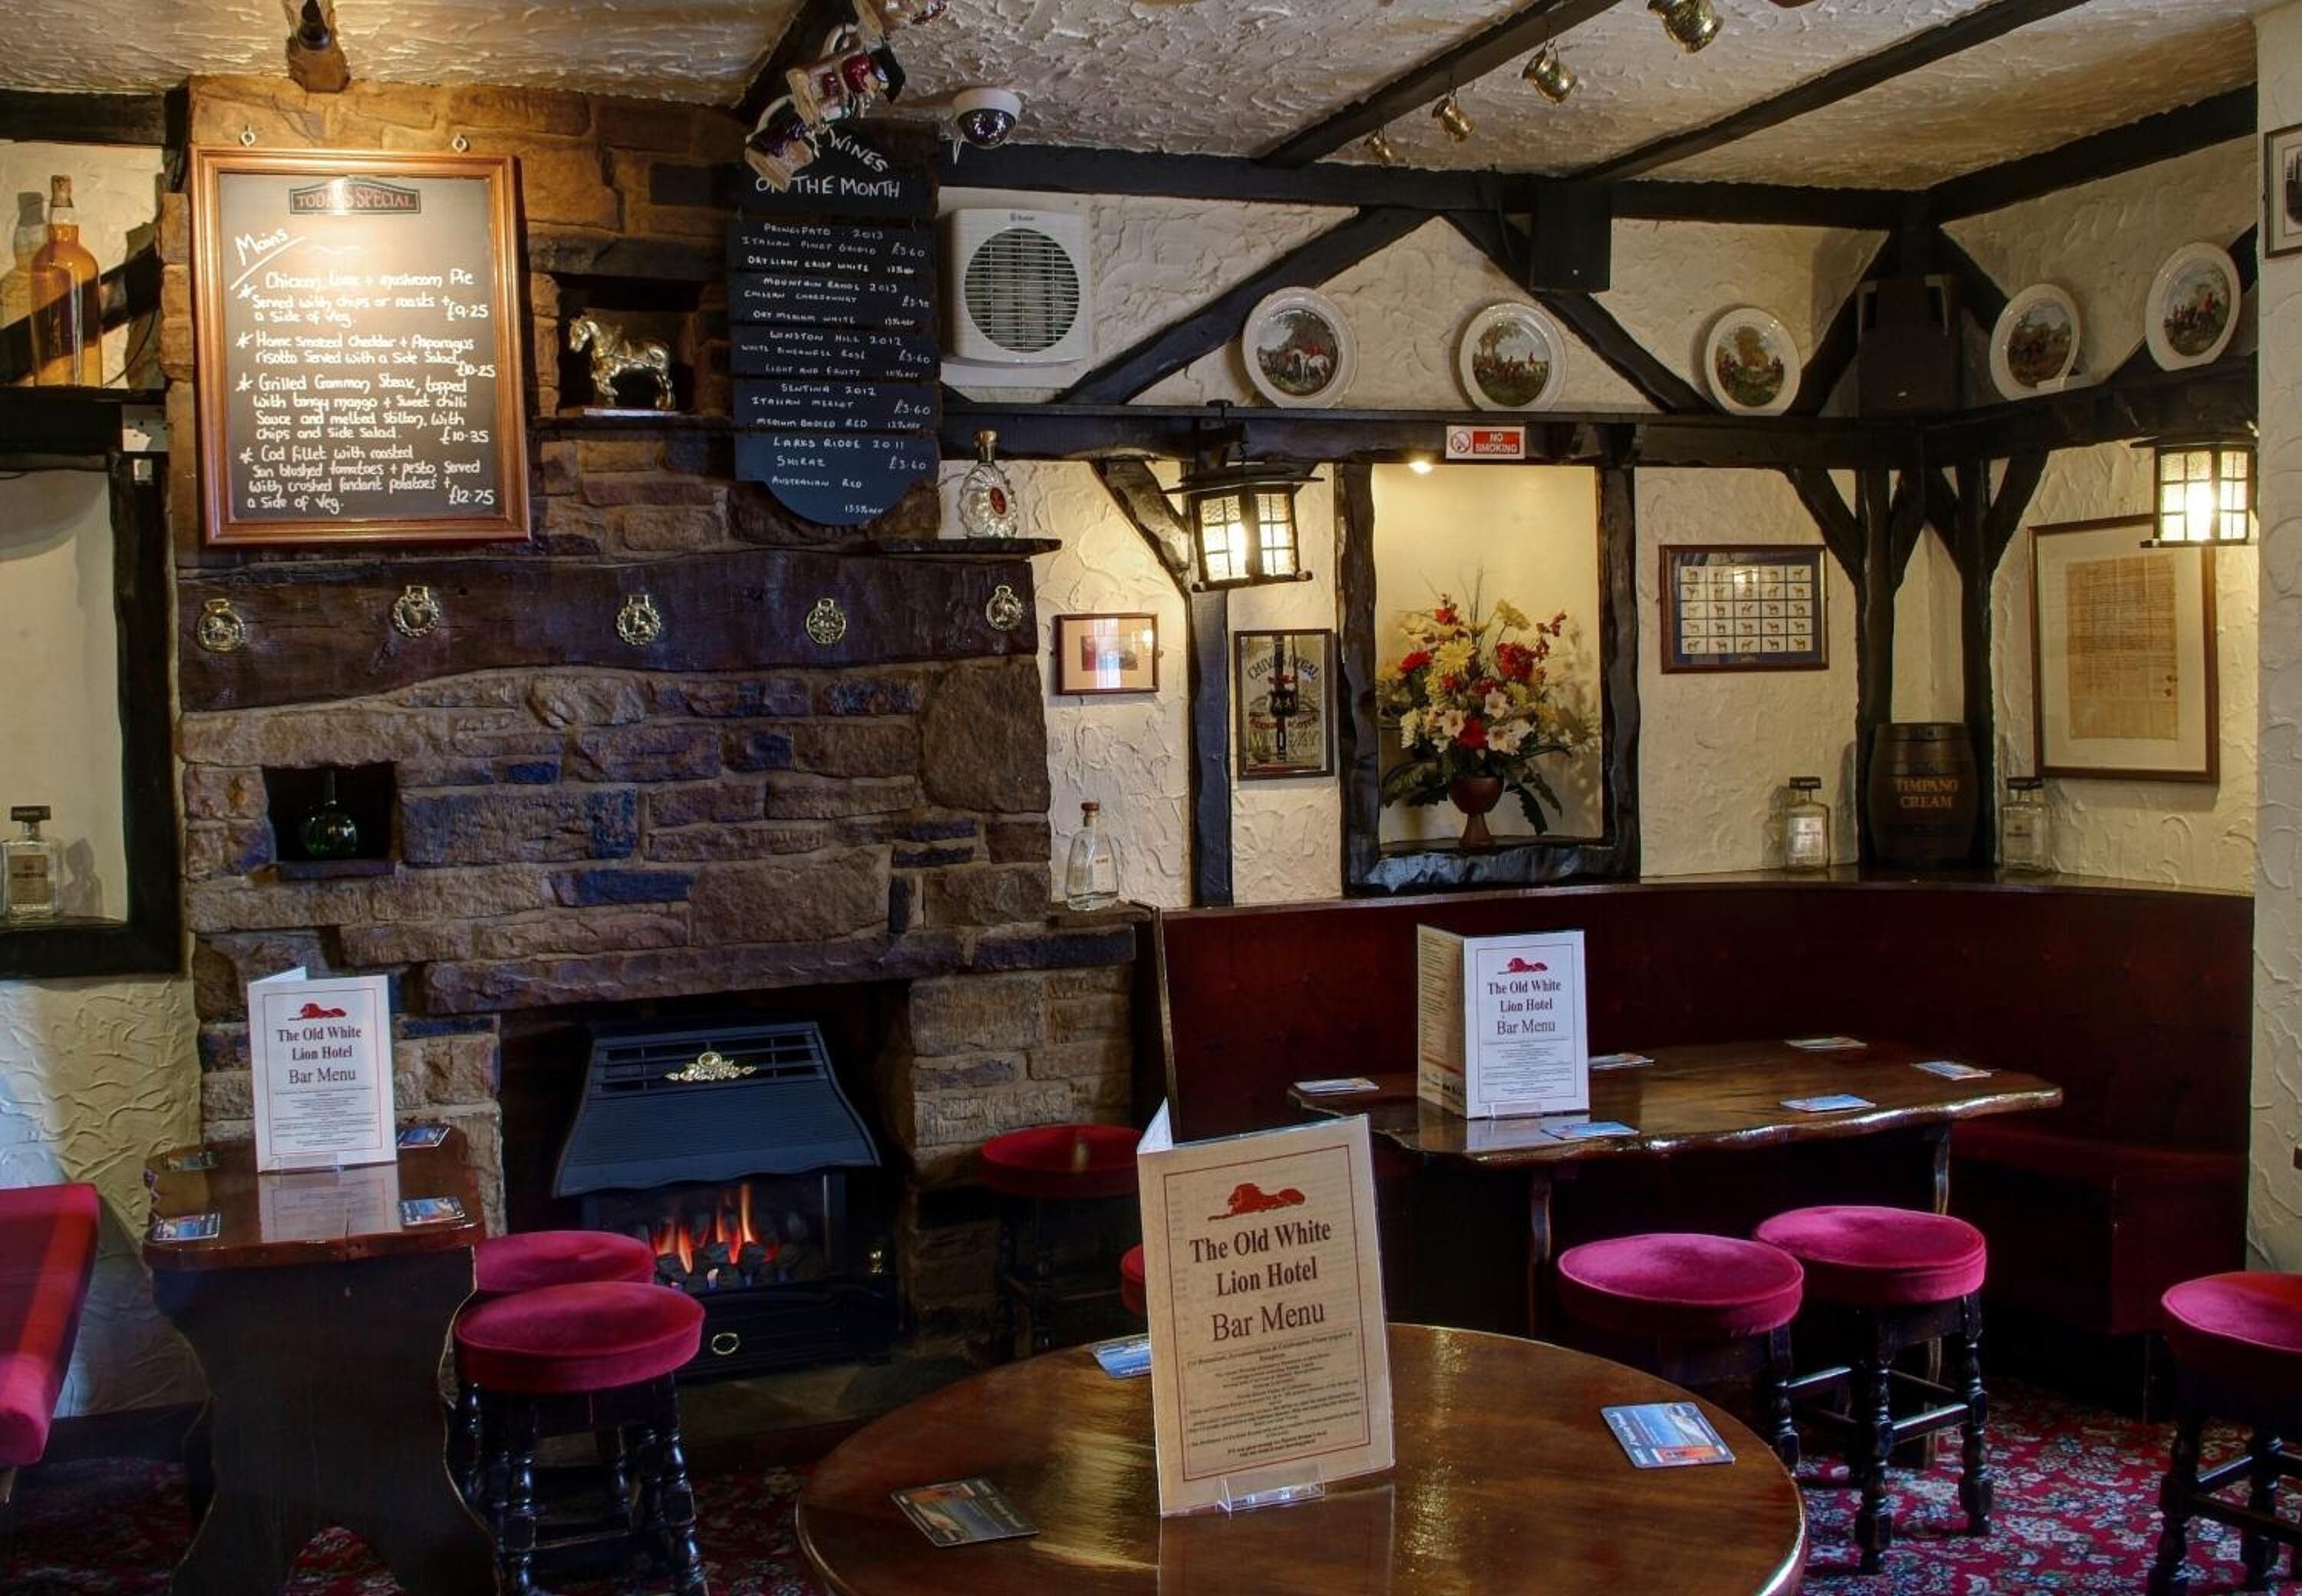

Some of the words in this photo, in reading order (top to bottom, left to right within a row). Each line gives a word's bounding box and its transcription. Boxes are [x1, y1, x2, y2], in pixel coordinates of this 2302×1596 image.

[829, 128, 889, 173] WINES
[791, 176, 835, 194] THE
[841, 177, 900, 197] MONTH
[355, 186, 414, 209] SPECIAL
[853, 229, 883, 239] 2013
[234, 228, 289, 266] Mains
[450, 269, 473, 285] Pie
[306, 311, 320, 325] of
[256, 330, 291, 347] Home
[869, 335, 902, 345] 2012
[255, 350, 298, 364] risotto
[345, 351, 375, 364] with
[259, 373, 308, 391] Grilled
[846, 386, 876, 396] 2012
[292, 392, 330, 412] tangy
[334, 397, 378, 412] mango
[300, 408, 324, 425] and
[330, 411, 376, 425] melted
[846, 419, 868, 428] RED
[297, 427, 322, 440] and
[1489, 432, 1503, 442] NO
[261, 444, 285, 461] Cod
[292, 446, 327, 461] fillet
[334, 446, 366, 459] with
[370, 444, 414, 460] roasted
[873, 440, 904, 450] 2011
[1475, 443, 1518, 453] SMOKING
[279, 463, 323, 481] blushed
[331, 463, 384, 476] tomatoes
[288, 477, 332, 492] crushed
[389, 476, 437, 493] potatoes
[295, 496, 308, 512] of
[1900, 795, 1953, 809] CREAM
[1486, 982, 1507, 995] The
[1509, 980, 1529, 994] Old
[1531, 978, 1562, 993] White
[1499, 1000, 1522, 1013] Lion
[1525, 998, 1553, 1011] Hotel
[277, 1028, 300, 1042] The
[303, 1027, 324, 1041] Old
[327, 1024, 361, 1040] White
[1497, 1021, 1519, 1035] Bar
[1521, 1018, 1555, 1034] Menu
[292, 1047, 318, 1062] Lion
[322, 1045, 353, 1059] Hotel
[289, 1069, 313, 1084] Bar
[317, 1067, 356, 1083] Menu
[1189, 1237, 1228, 1265] The
[1233, 1225, 1269, 1256] Old
[1274, 1218, 1332, 1249] White
[1215, 1270, 1261, 1298] Lion
[1266, 1255, 1318, 1290] Hotel
[1211, 1309, 1253, 1343] Bar
[1260, 1300, 1326, 1334] Menu
